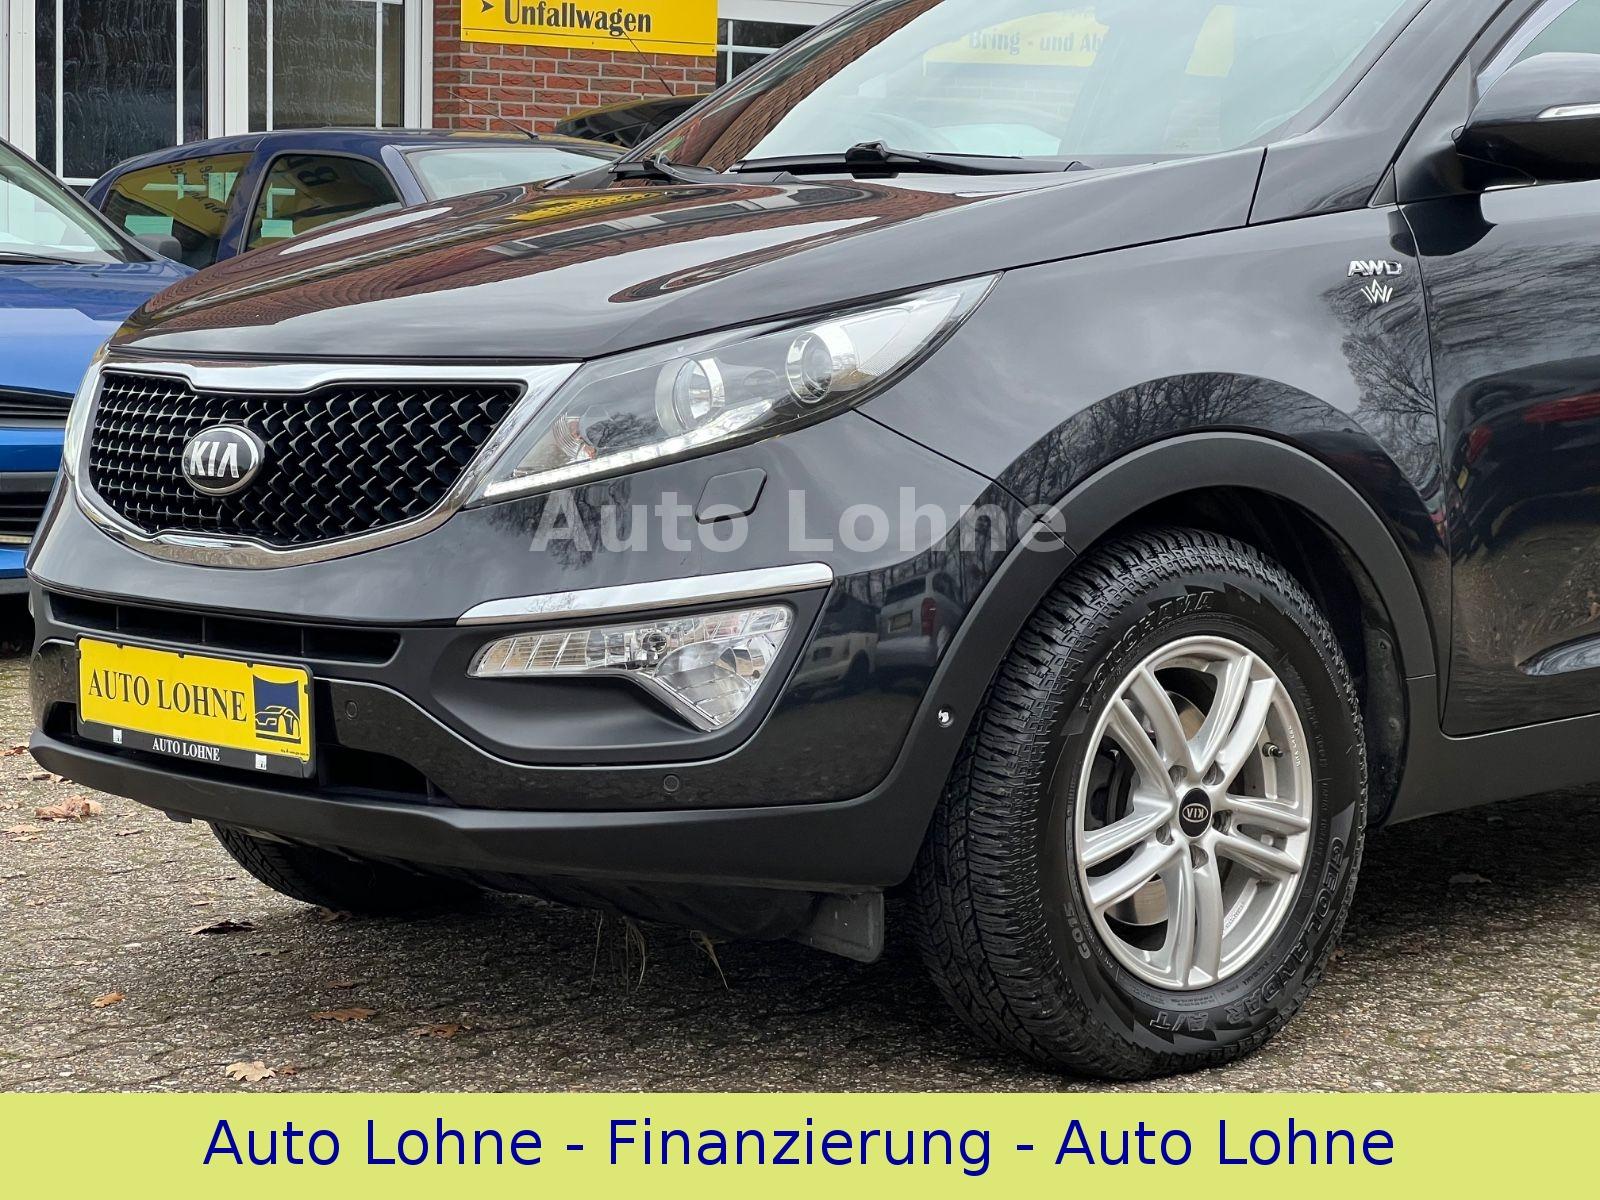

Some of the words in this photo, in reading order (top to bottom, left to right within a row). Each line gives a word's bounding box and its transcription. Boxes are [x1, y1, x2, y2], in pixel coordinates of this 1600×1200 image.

[504, 0, 651, 37] Unfallwagen
[1039, 32, 1074, 51] und
[1347, 259, 1402, 277] AWD
[189, 440, 239, 478] KIA
[88, 667, 151, 706] AUTO
[157, 678, 247, 722] LOHNE
[152, 737, 180, 755] AUTO
[182, 741, 220, 762] LOHNE
